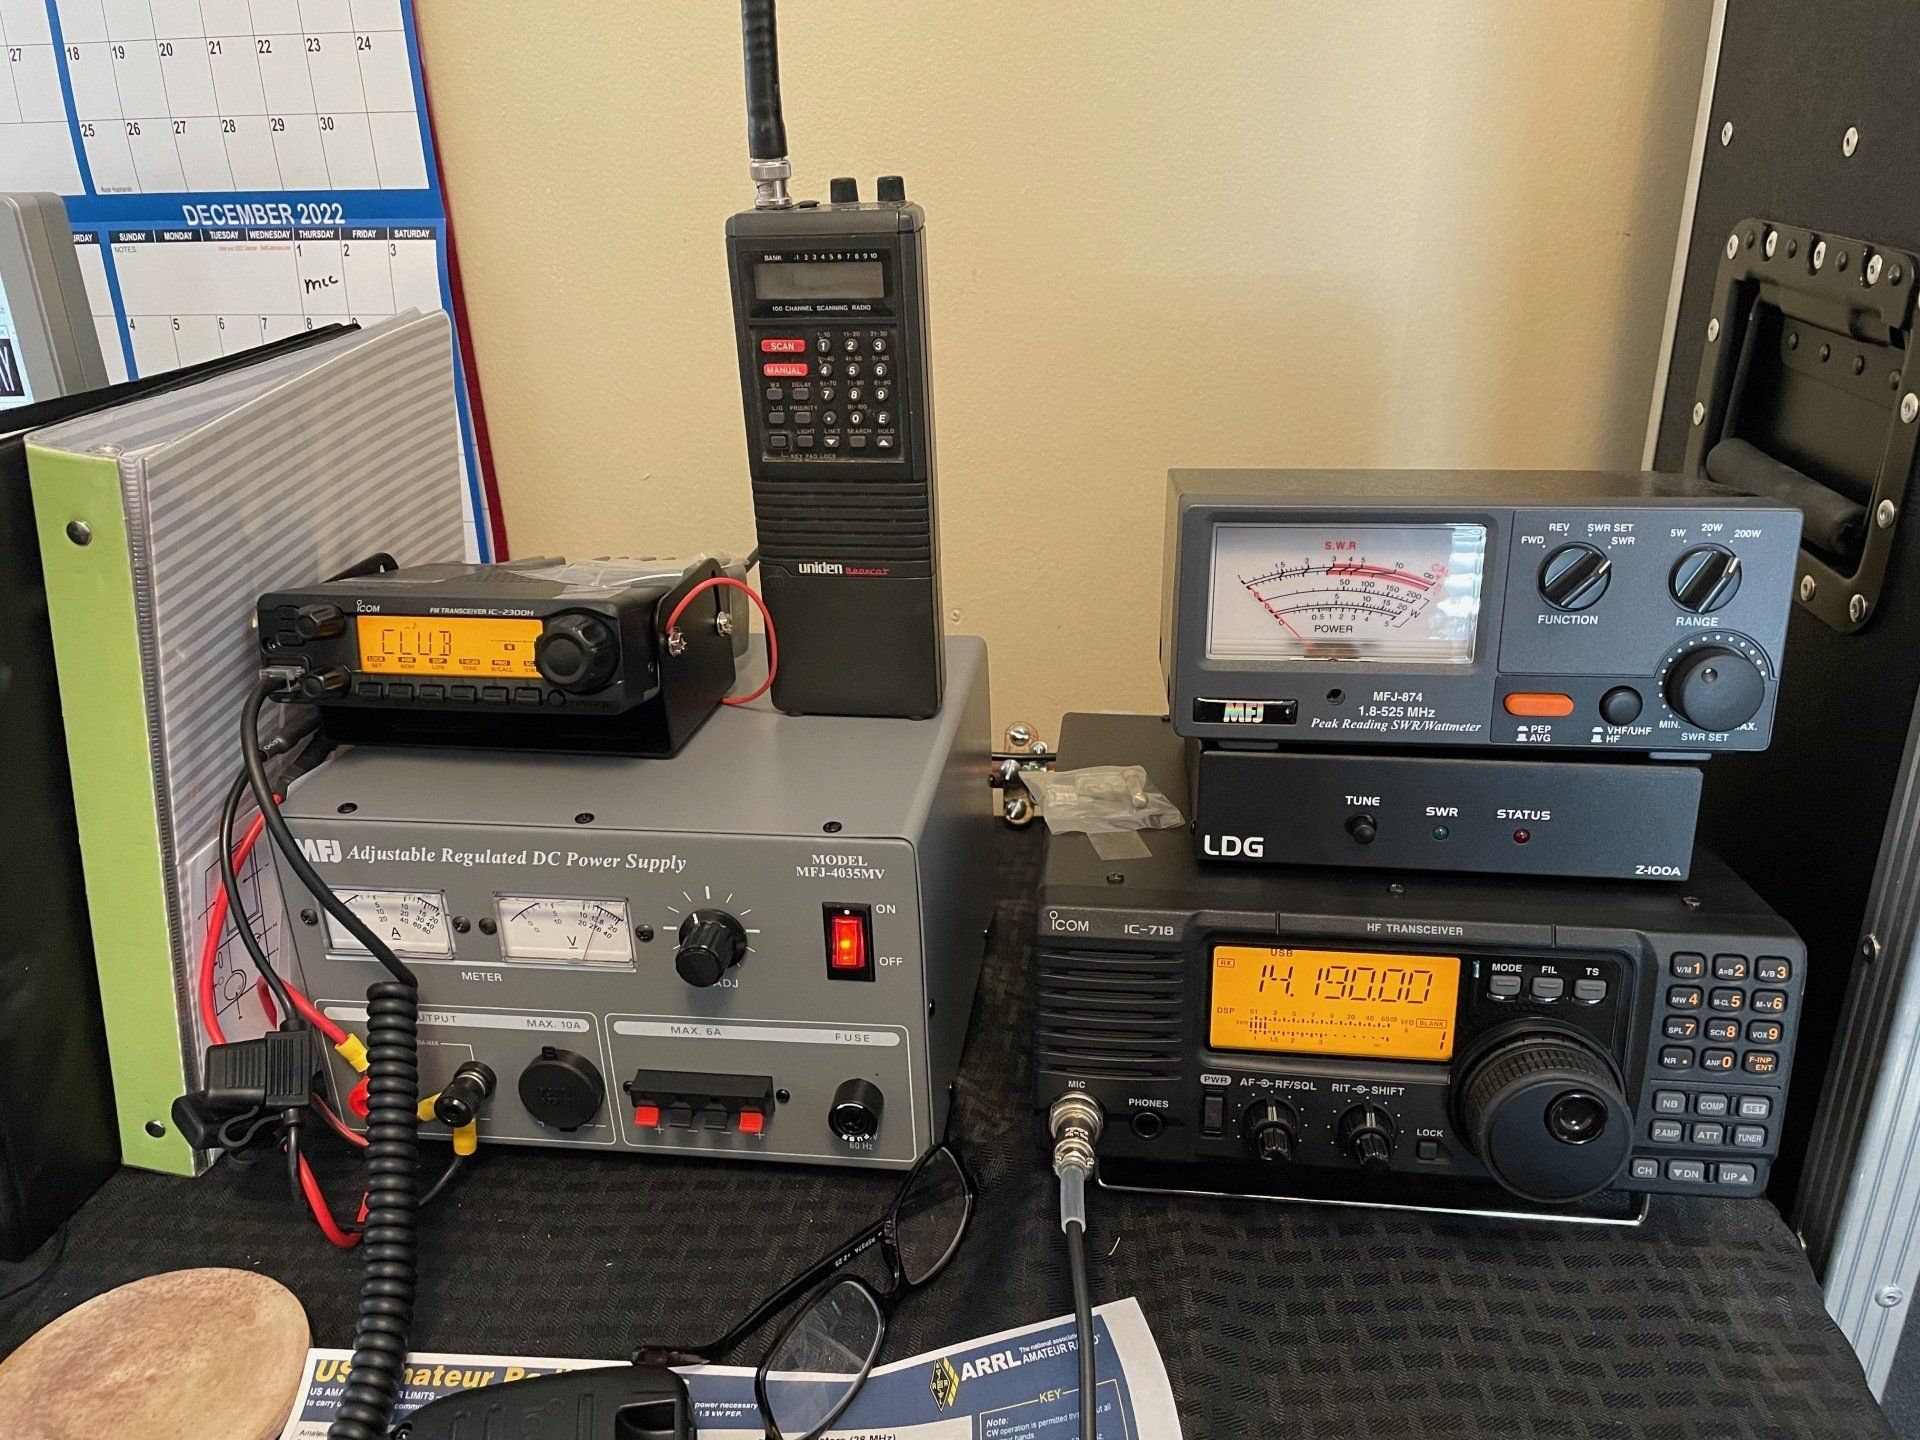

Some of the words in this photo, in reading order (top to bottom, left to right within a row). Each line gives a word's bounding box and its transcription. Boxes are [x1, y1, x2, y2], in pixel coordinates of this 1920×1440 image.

[209, 41, 223, 55] 21
[258, 39, 272, 54] 22
[306, 38, 321, 53] 23
[357, 36, 371, 51] 24
[10, 47, 23, 62] 27
[67, 47, 80, 61] 18
[112, 46, 125, 60] 19
[159, 43, 173, 57] 20
[127, 122, 141, 136] 26
[173, 121, 187, 135] 27
[221, 119, 236, 133] 28
[270, 118, 285, 132] 29
[320, 117, 334, 131] 30
[81, 124, 95, 137] 25
[183, 203, 295, 225] DECEMBER
[298, 203, 345, 224] 2022
[119, 232, 146, 241] SUNDAY
[164, 232, 193, 240] MONDAY
[210, 231, 239, 239] TUESDAY
[250, 231, 290, 239] WEDNESDAY
[299, 230, 334, 239] THURSDAY
[352, 230, 377, 238] FRIDAY
[394, 229, 430, 238] SATURDAY
[767, 366, 801, 374] MANUAL
[1549, 523, 1570, 532] REV
[1587, 523, 1611, 532] SWR
[1614, 524, 1634, 532] SET
[1670, 528, 1686, 538] 5W
[1701, 523, 1722, 532] 20W
[1734, 529, 1761, 538] 200W
[1521, 536, 1544, 545] FWD
[1611, 536, 1635, 545] SWR
[798, 562, 843, 575] uniden
[1386, 584, 1400, 593] 150
[1406, 591, 1422, 600] 200
[488, 608, 534, 616] IC-2300H
[1537, 614, 1599, 625] FUNCTION
[1676, 616, 1718, 627] RANGE
[1314, 624, 1353, 633] POWER
[382, 629, 451, 656] CLUB
[1373, 691, 1423, 702] MFJ-874
[1223, 702, 1263, 723] MFJ
[1358, 705, 1403, 717] 1.8-525
[1407, 706, 1435, 718] MHz
[1311, 718, 1338, 729] Peak
[1342, 719, 1387, 731] Reading
[1391, 720, 1481, 732] SWR/Wattmeter
[1530, 725, 1551, 733] PEP
[1659, 720, 1680, 729] MIN.
[1607, 726, 1652, 735] VHF/UHF
[1529, 733, 1551, 742] AVG
[1606, 734, 1620, 743] HF
[1681, 732, 1705, 741] SWR
[1708, 733, 1729, 742] SET
[1345, 795, 1380, 806] TUNE
[1425, 806, 1458, 817] SWR
[1496, 809, 1551, 821] STATUS
[1203, 835, 1264, 857] LDG
[296, 839, 342, 863] MFJ
[347, 844, 436, 863] Adjustable
[441, 847, 527, 866] Regulated
[532, 851, 561, 866] DC
[567, 853, 621, 869] Power
[626, 854, 687, 873] Supply
[812, 855, 867, 866] MODEL
[796, 866, 885, 879] MFJ-4035MV
[1635, 864, 1682, 876] Z-100A
[876, 905, 895, 914] ON
[391, 927, 401, 937] A
[1124, 923, 1174, 936] IC-718
[1367, 923, 1383, 933] HF
[1386, 924, 1464, 936] TRANSCEIVER
[567, 936, 576, 946] V
[1271, 949, 1293, 957] USB
[879, 957, 902, 966] OFF
[1491, 963, 1523, 973] MODE
[1541, 966, 1558, 974] FIL
[1585, 967, 1600, 976] TS
[1693, 962, 1700, 975] 1
[1734, 964, 1744, 977] 2
[1776, 966, 1787, 979] 3
[461, 971, 503, 982] METER
[1688, 993, 1698, 1005] 4
[1730, 995, 1741, 1007] 5
[1772, 997, 1783, 1010] 6
[561, 1020, 582, 1031] 10A
[1668, 1026, 1683, 1034] SPL
[1685, 1023, 1695, 1035] 7
[706, 1027, 722, 1037] 6A
[1726, 1026, 1736, 1038] 8
[1752, 1031, 1767, 1039] VOX
[1768, 1028, 1778, 1040] 9
[834, 1033, 871, 1043] FUSE
[1722, 1056, 1732, 1068] 0
[1067, 1080, 1086, 1089] MIC
[1204, 1075, 1228, 1084] PWR
[1240, 1078, 1255, 1087] AF
[1275, 1079, 1317, 1092] RF/SQL
[1331, 1083, 1350, 1093] RIT
[1371, 1085, 1405, 1097] SHIFT
[1128, 1098, 1169, 1108] PHONES
[1662, 1100, 1678, 1108] NB
[1700, 1102, 1724, 1111] COMP
[1416, 1128, 1443, 1138] LOCK
[1654, 1129, 1680, 1137] P.AMP
[1697, 1132, 1719, 1140] ATT
[1737, 1134, 1762, 1143] TUNER
[862, 1142, 873, 1150] Hz
[1637, 1166, 1653, 1175] CH
[1684, 1170, 1699, 1178] DN
[1723, 1172, 1738, 1181] UP
[1023, 1343, 1069, 1364] AMATEUR
[960, 1351, 1022, 1382] ARRL
[310, 1387, 323, 1395] US
[405, 1391, 435, 1400] LIMITS
[1039, 1388, 1061, 1403] KEY
[315, 1400, 336, 1408] carry
[986, 1417, 1008, 1428] Note:
[986, 1429, 999, 1437] CW
[1000, 1423, 1030, 1436] operation
[1038, 1414, 1067, 1428] permitted
